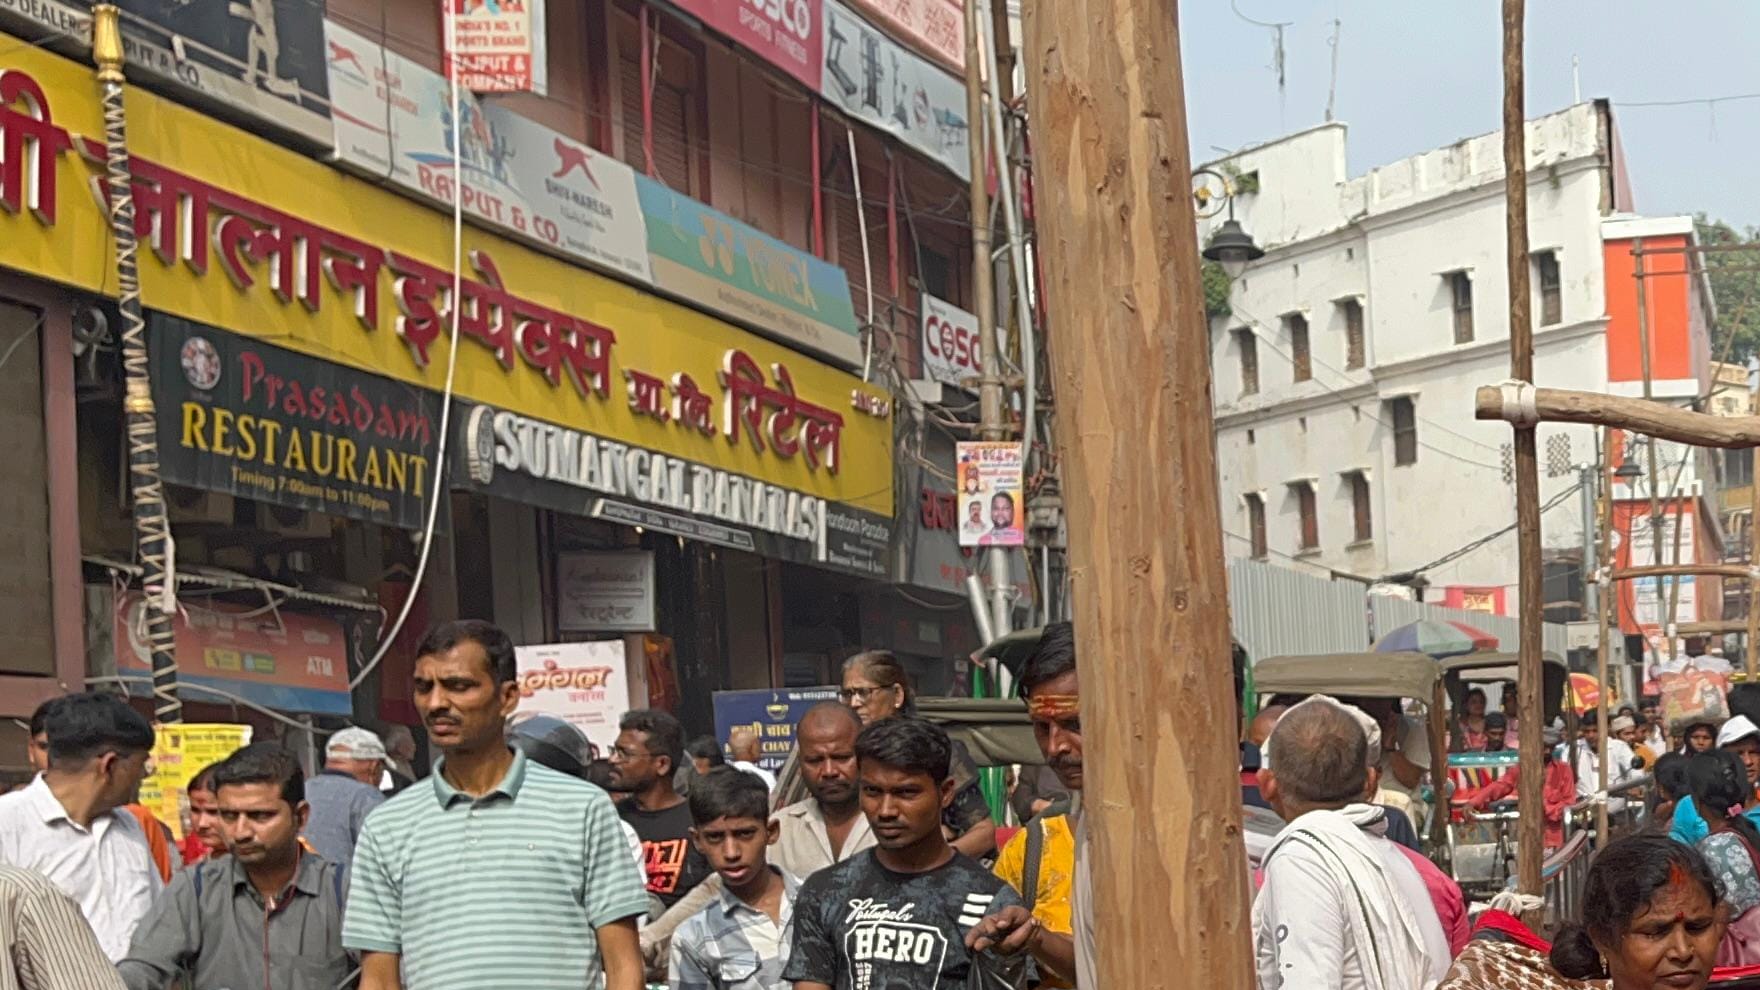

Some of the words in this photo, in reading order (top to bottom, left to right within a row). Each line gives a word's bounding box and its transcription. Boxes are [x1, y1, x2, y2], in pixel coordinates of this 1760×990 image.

[455, 34, 488, 47] PORTS
[455, 54, 510, 72] AJPUT
[512, 56, 525, 71] &
[417, 162, 504, 224] RAPUT
[511, 206, 527, 232] &
[239, 350, 432, 448] Prasadam
[716, 348, 845, 476] रिटेल
[180, 401, 429, 498] RESTAURANT
[494, 409, 692, 508] SUMANGAL
[691, 464, 820, 543] BANARAS
[231, 464, 276, 492] Timing
[305, 654, 334, 677] ATM
[854, 926, 935, 966] HERO
